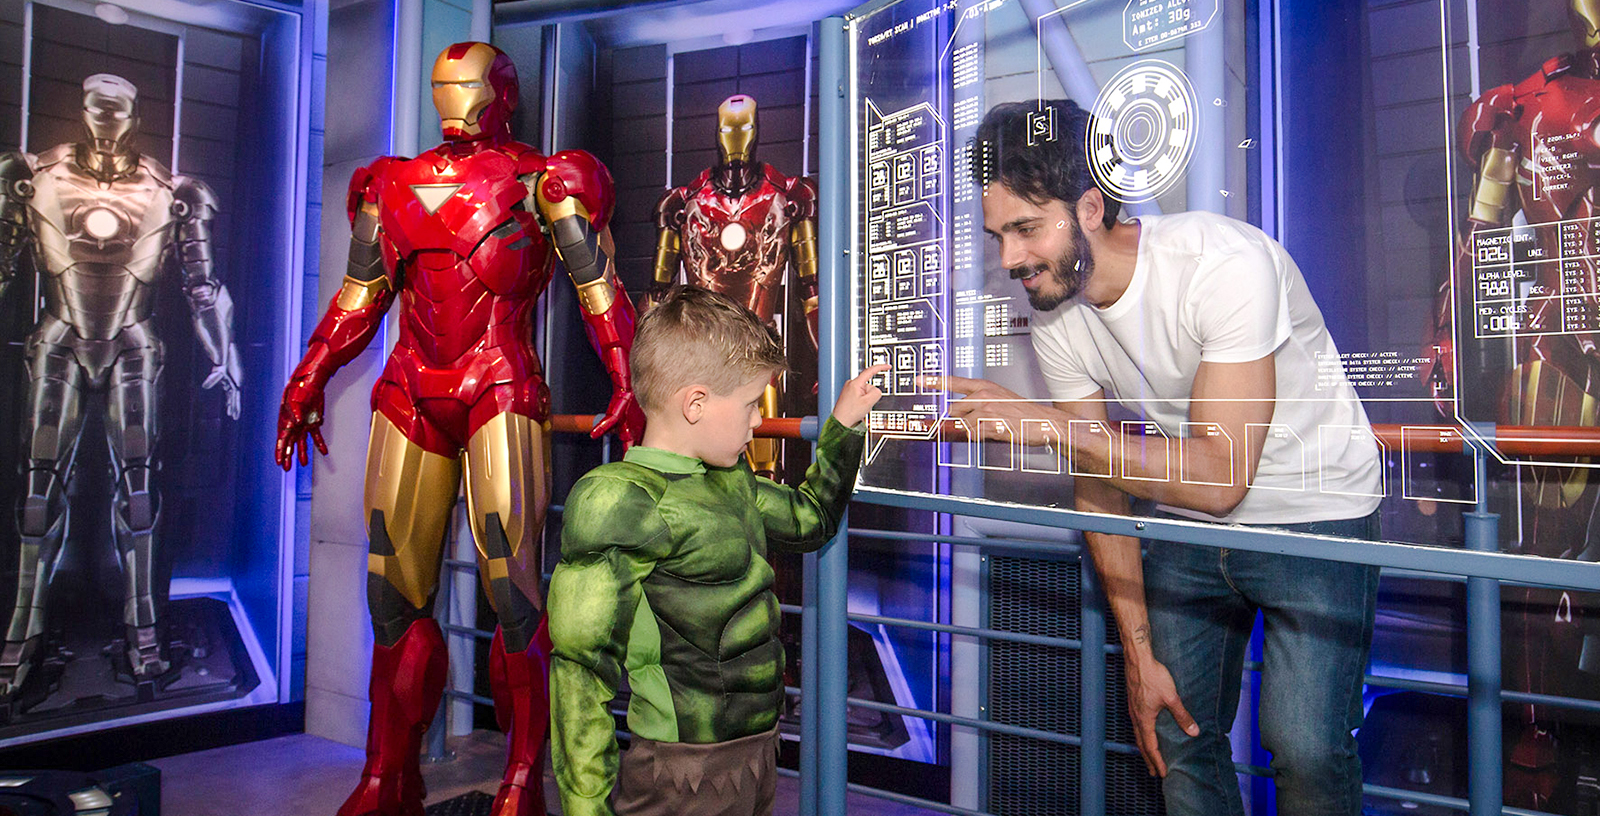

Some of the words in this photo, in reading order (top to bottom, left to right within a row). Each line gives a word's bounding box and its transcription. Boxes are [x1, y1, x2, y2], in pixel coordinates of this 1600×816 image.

[1131, 4, 1164, 22] IONIZED
[1132, 18, 1159, 36] Amt:
[1168, 8, 1190, 24] 30g
[1477, 235, 1512, 246] MAGNETIC
[1478, 246, 1508, 262] 026
[1527, 248, 1543, 257] UNI
[1478, 271, 1500, 281] ALPHA
[1502, 269, 1526, 279] LEVEL
[1479, 280, 1509, 296] 988
[1529, 286, 1544, 294] DEC
[1479, 307, 1496, 315] MED.
[1500, 305, 1527, 314] CYCLES
